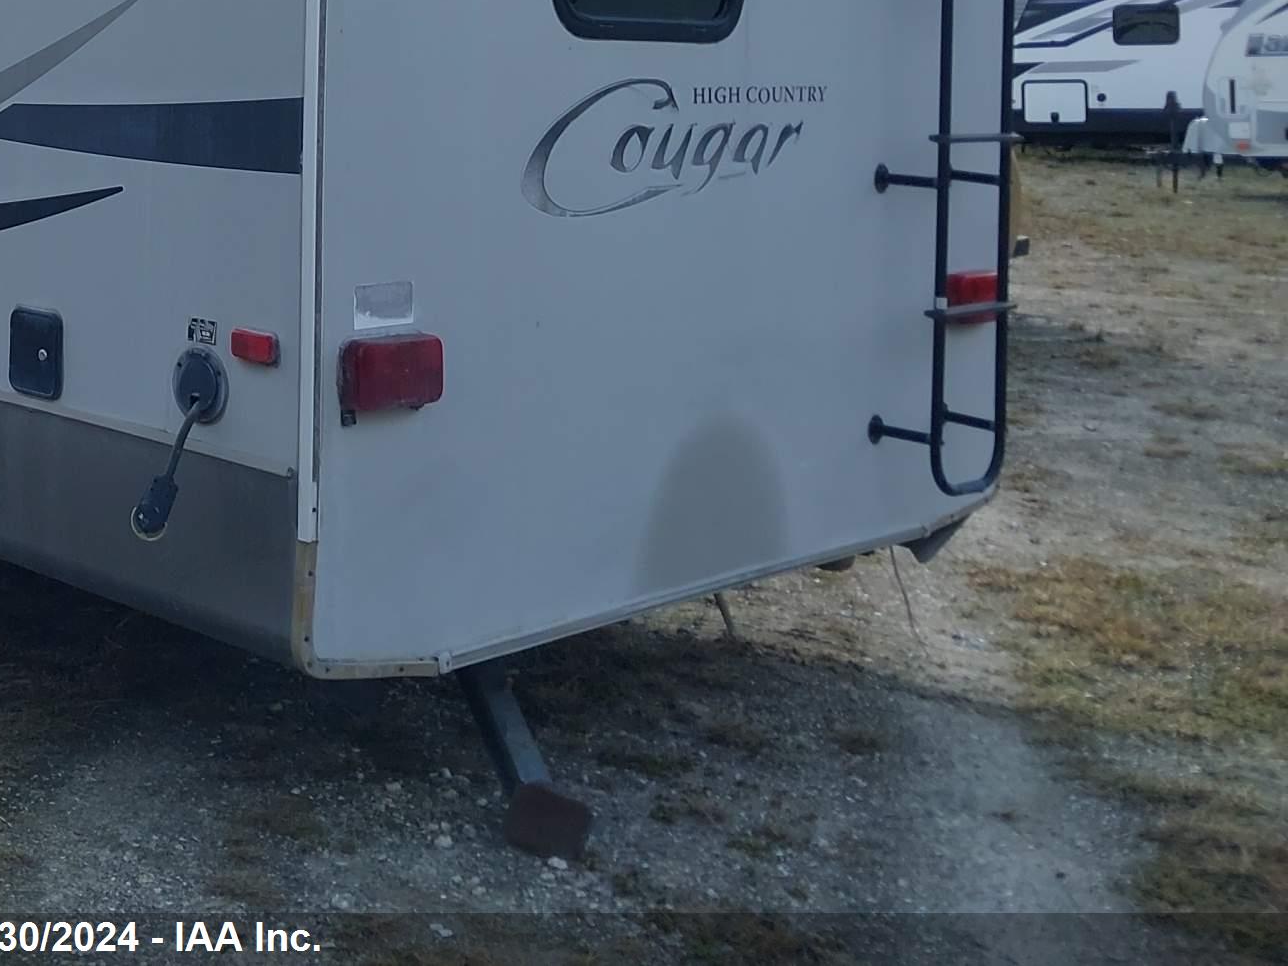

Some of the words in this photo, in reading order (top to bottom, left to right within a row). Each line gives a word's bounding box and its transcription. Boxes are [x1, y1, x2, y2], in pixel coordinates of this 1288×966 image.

[692, 86, 742, 105] HIGH
[745, 84, 828, 104] COUNTRY
[520, 78, 804, 218] Cougar
